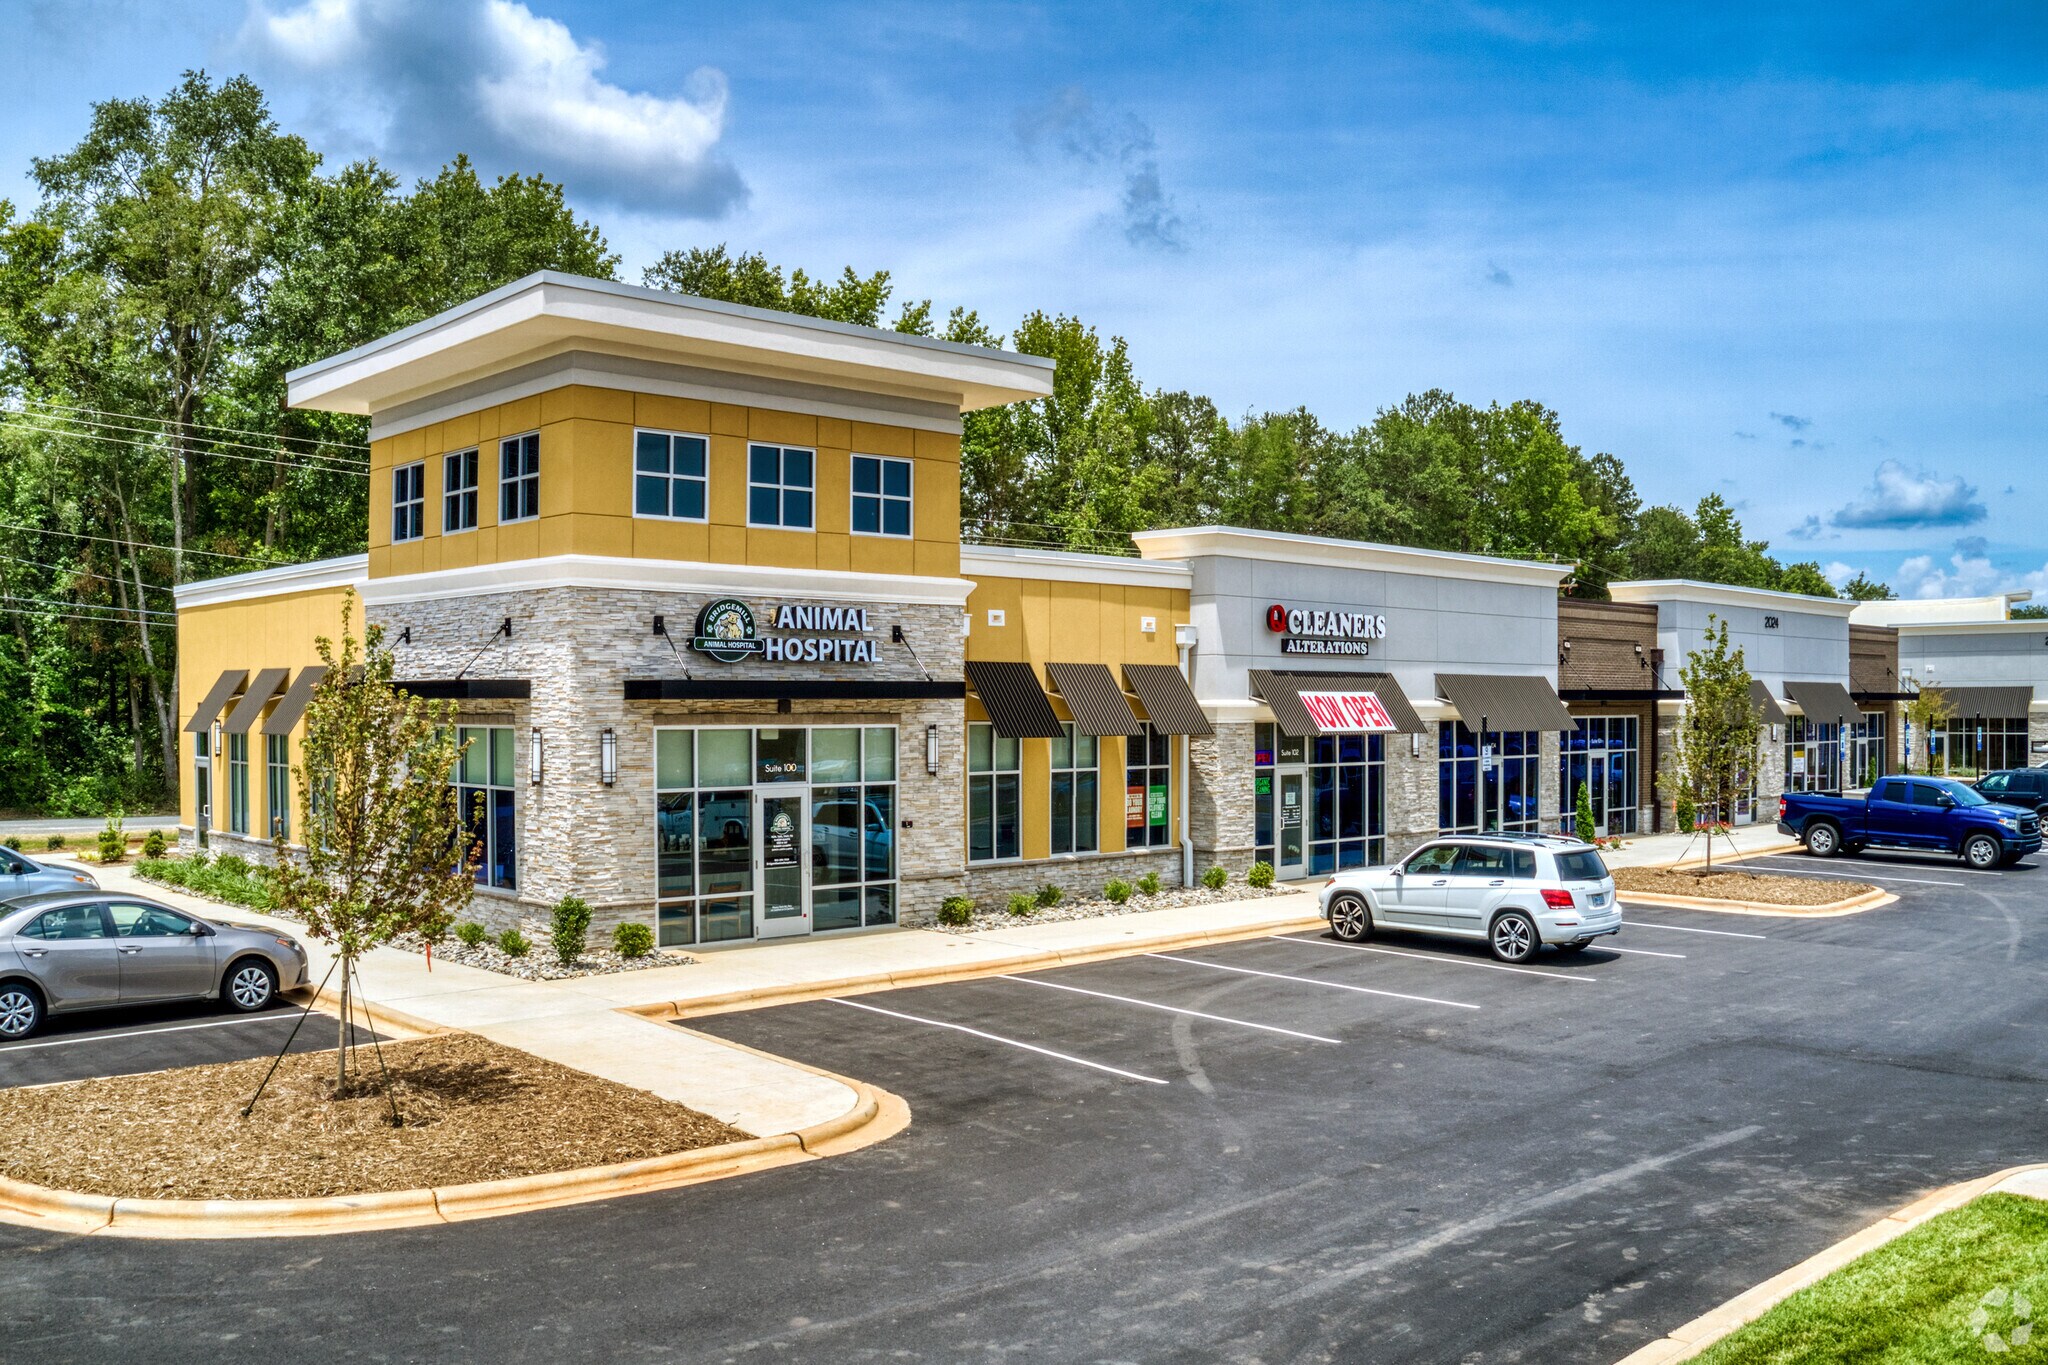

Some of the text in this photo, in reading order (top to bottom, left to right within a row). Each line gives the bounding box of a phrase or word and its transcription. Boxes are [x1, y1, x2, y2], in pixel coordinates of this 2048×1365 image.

[709, 603, 751, 624] BRIDGEMILL
[777, 605, 874, 632] ANIMAL
[1267, 604, 1386, 639] Q CLEANERS
[1764, 616, 1779, 629] 2024
[703, 640, 756, 650] ANIMAL HOSPITAL
[766, 637, 883, 663] HOSPITAL
[1286, 640, 1368, 655] ALTERATIONS
[1301, 695, 1393, 729] NOW OPEN
[1255, 753, 1270, 763] PEN
[765, 763, 797, 773] Suite 100
